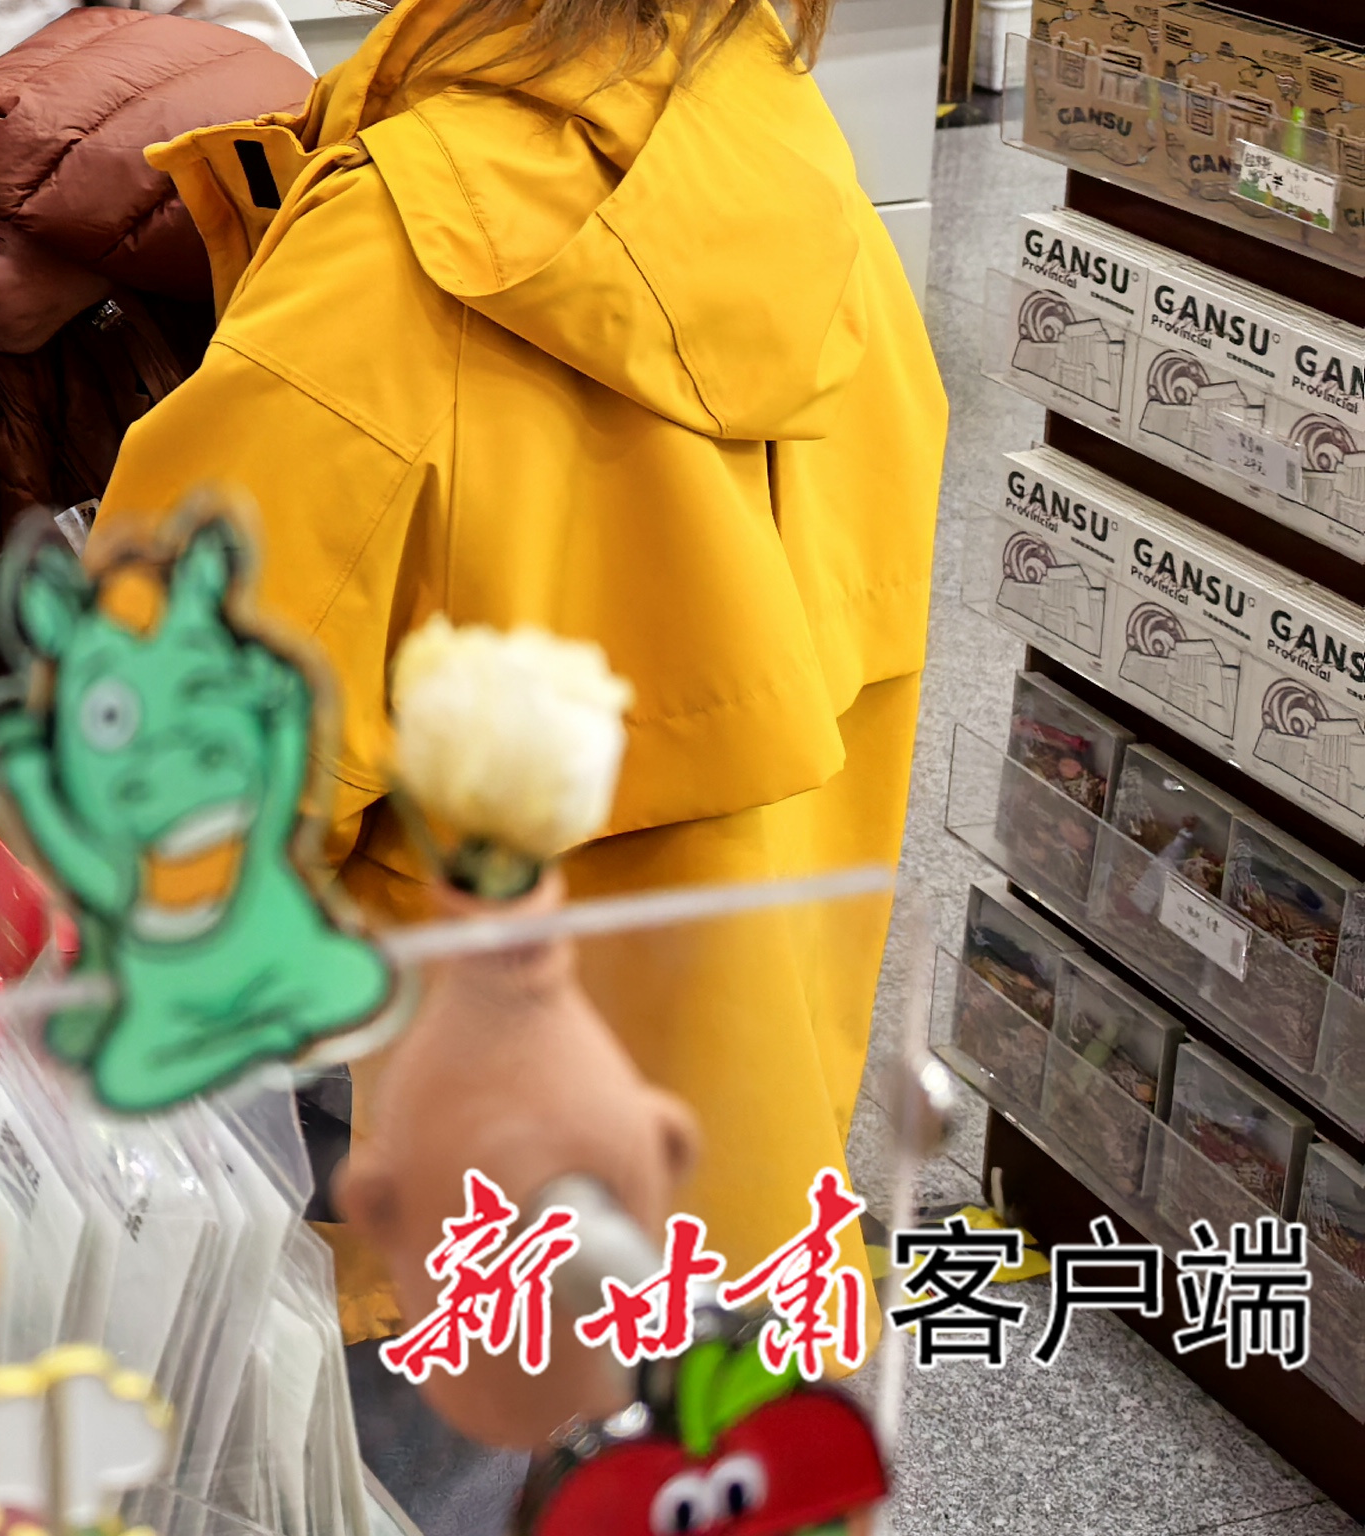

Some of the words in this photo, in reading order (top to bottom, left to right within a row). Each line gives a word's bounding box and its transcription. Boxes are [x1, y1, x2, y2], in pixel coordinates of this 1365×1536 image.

[1057, 107, 1133, 137] GANSU
[1022, 257, 1077, 290] Provincial
[1025, 229, 1130, 294] GANSU
[1150, 313, 1212, 350] Provincial
[1154, 284, 1270, 356] GANSU
[1291, 375, 1358, 415] Provincial
[1005, 497, 1059, 534] Provincial
[1007, 471, 1109, 542] GANSU
[1130, 565, 1189, 606] Provincial
[1133, 538, 1245, 617] GANSU
[1266, 638, 1332, 683] Provincial
